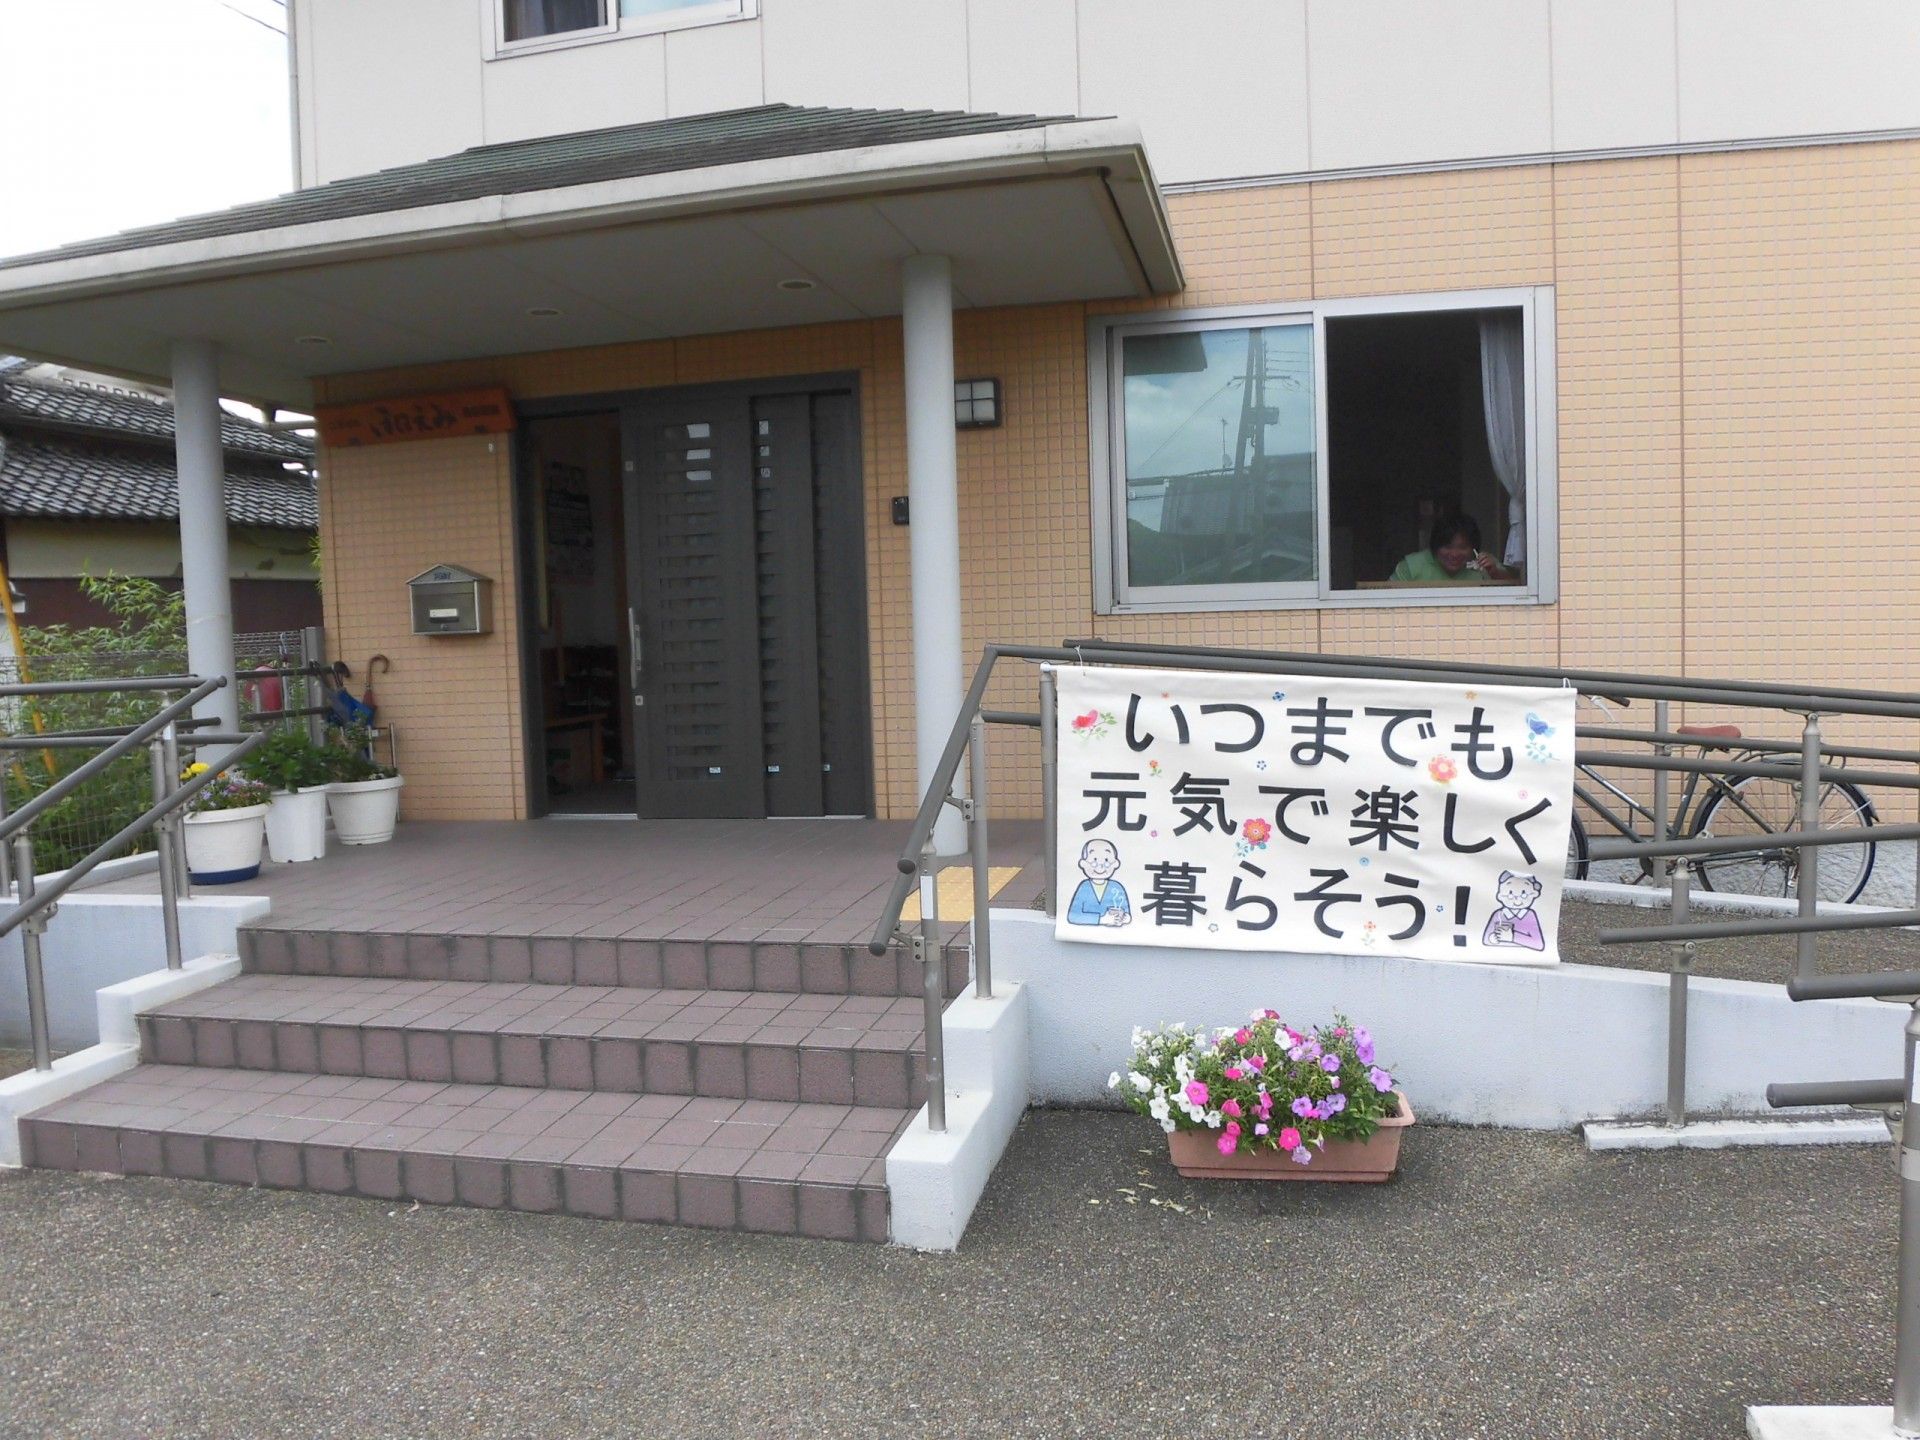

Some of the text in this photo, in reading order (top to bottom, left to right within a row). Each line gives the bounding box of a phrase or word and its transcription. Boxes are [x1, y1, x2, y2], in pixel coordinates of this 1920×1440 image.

[1126, 693, 1513, 781] いつまでも
[1082, 772, 1552, 866] 元気で楽しく
[1140, 861, 1471, 948] 暮らそう!
